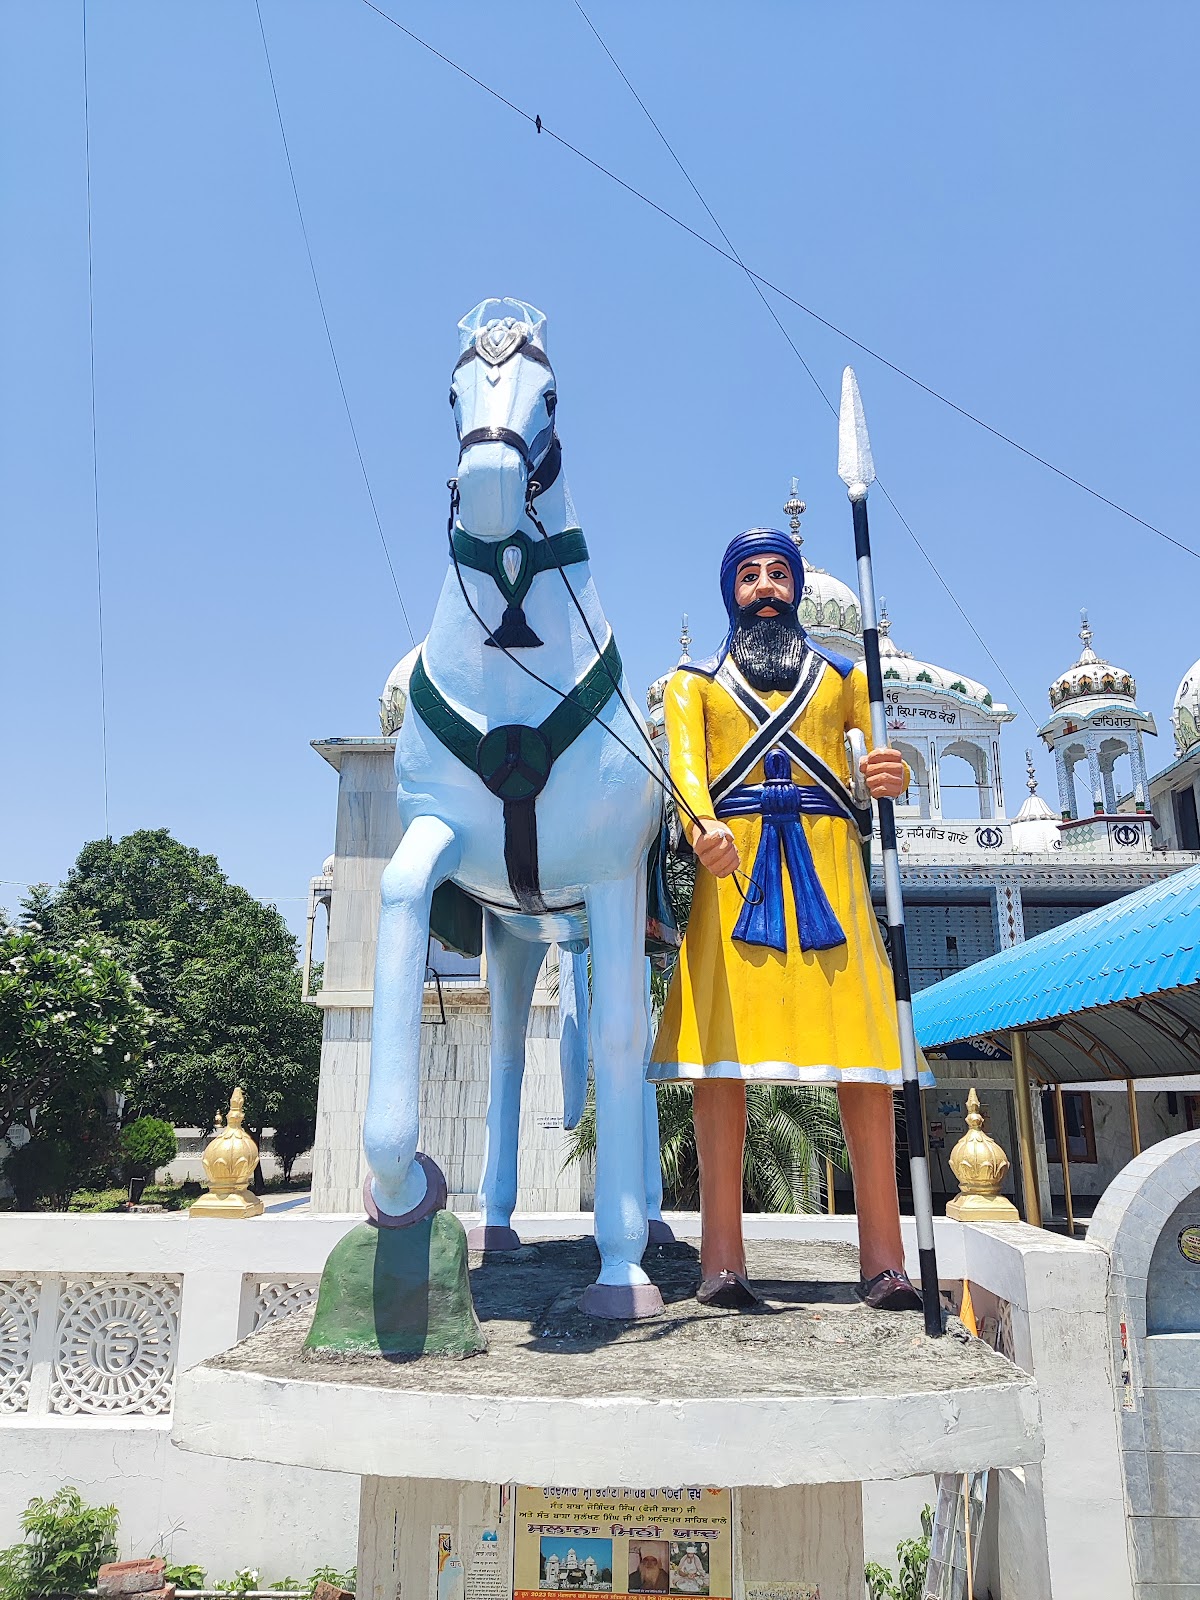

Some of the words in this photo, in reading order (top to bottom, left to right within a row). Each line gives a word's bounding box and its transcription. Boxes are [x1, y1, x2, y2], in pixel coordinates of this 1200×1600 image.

[884, 705, 894, 717] ਰੀ
[938, 709, 956, 725] ਕੇਰੀ
[925, 826, 945, 840] ਗੀਤ
[947, 831, 968, 845] ਗਾਏ
[618, 1503, 636, 1512] ਸਿੰਘ
[687, 1505, 697, 1514] ਜੀ
[519, 1510, 533, 1518] ਅਤੇ
[536, 1510, 549, 1519] ਸੰਤ
[603, 1513, 620, 1521] ਸਿੰਘ
[622, 1513, 633, 1522] ਜੀ
[635, 1514, 645, 1522] ਦੀ
[684, 1515, 709, 1524] ਸਾਹਿਬ
